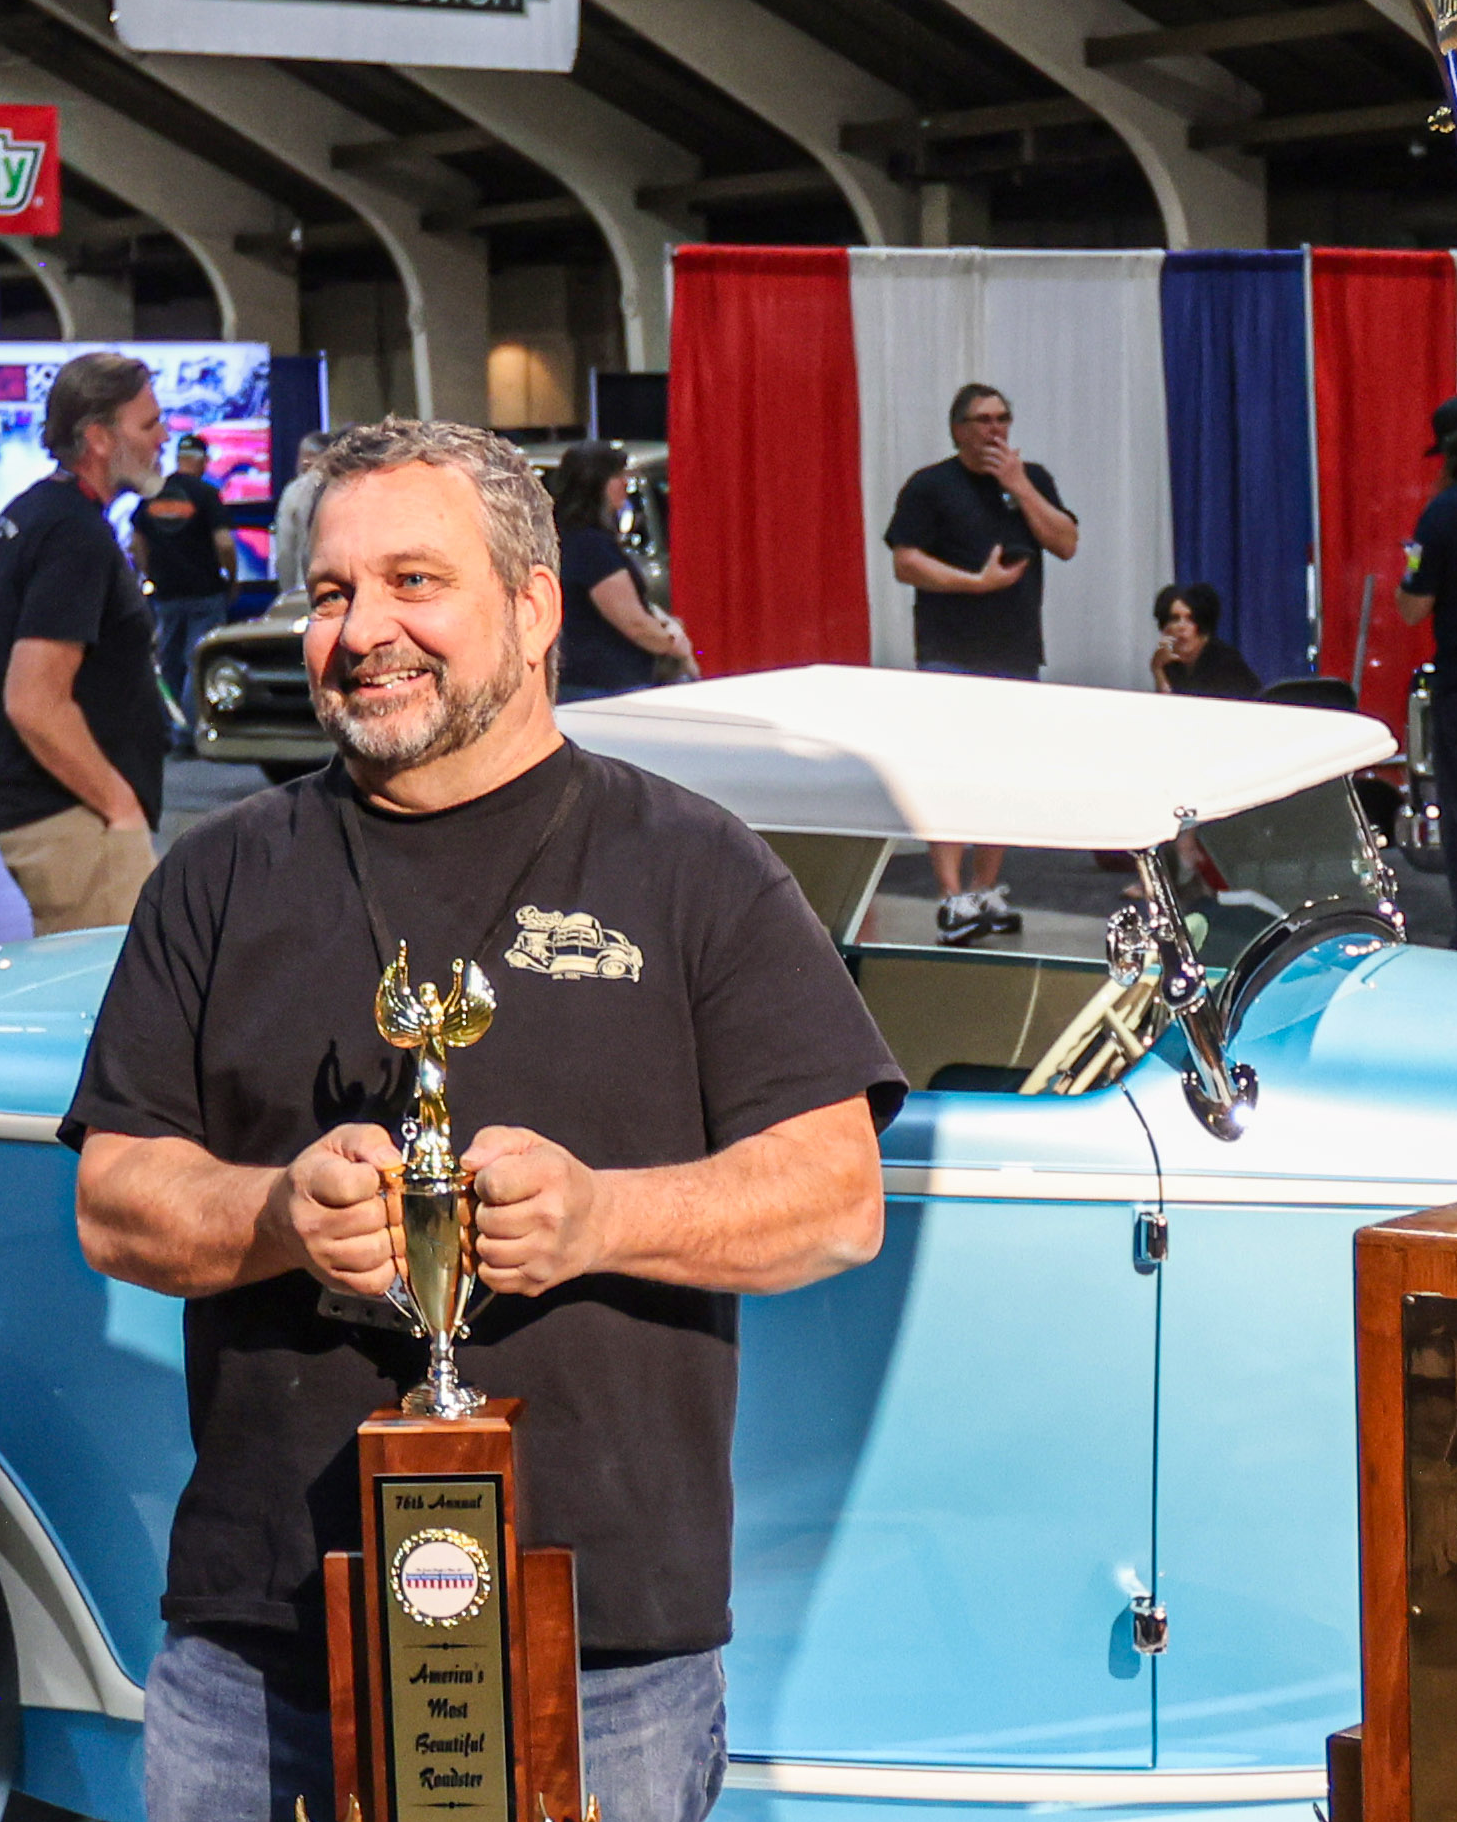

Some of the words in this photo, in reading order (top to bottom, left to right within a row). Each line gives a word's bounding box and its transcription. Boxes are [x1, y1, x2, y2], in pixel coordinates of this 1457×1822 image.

[409, 1662, 485, 1685] America's
[427, 1698, 468, 1719] Most
[415, 1732, 486, 1758] Beautiful
[419, 1767, 484, 1791] Roadster
